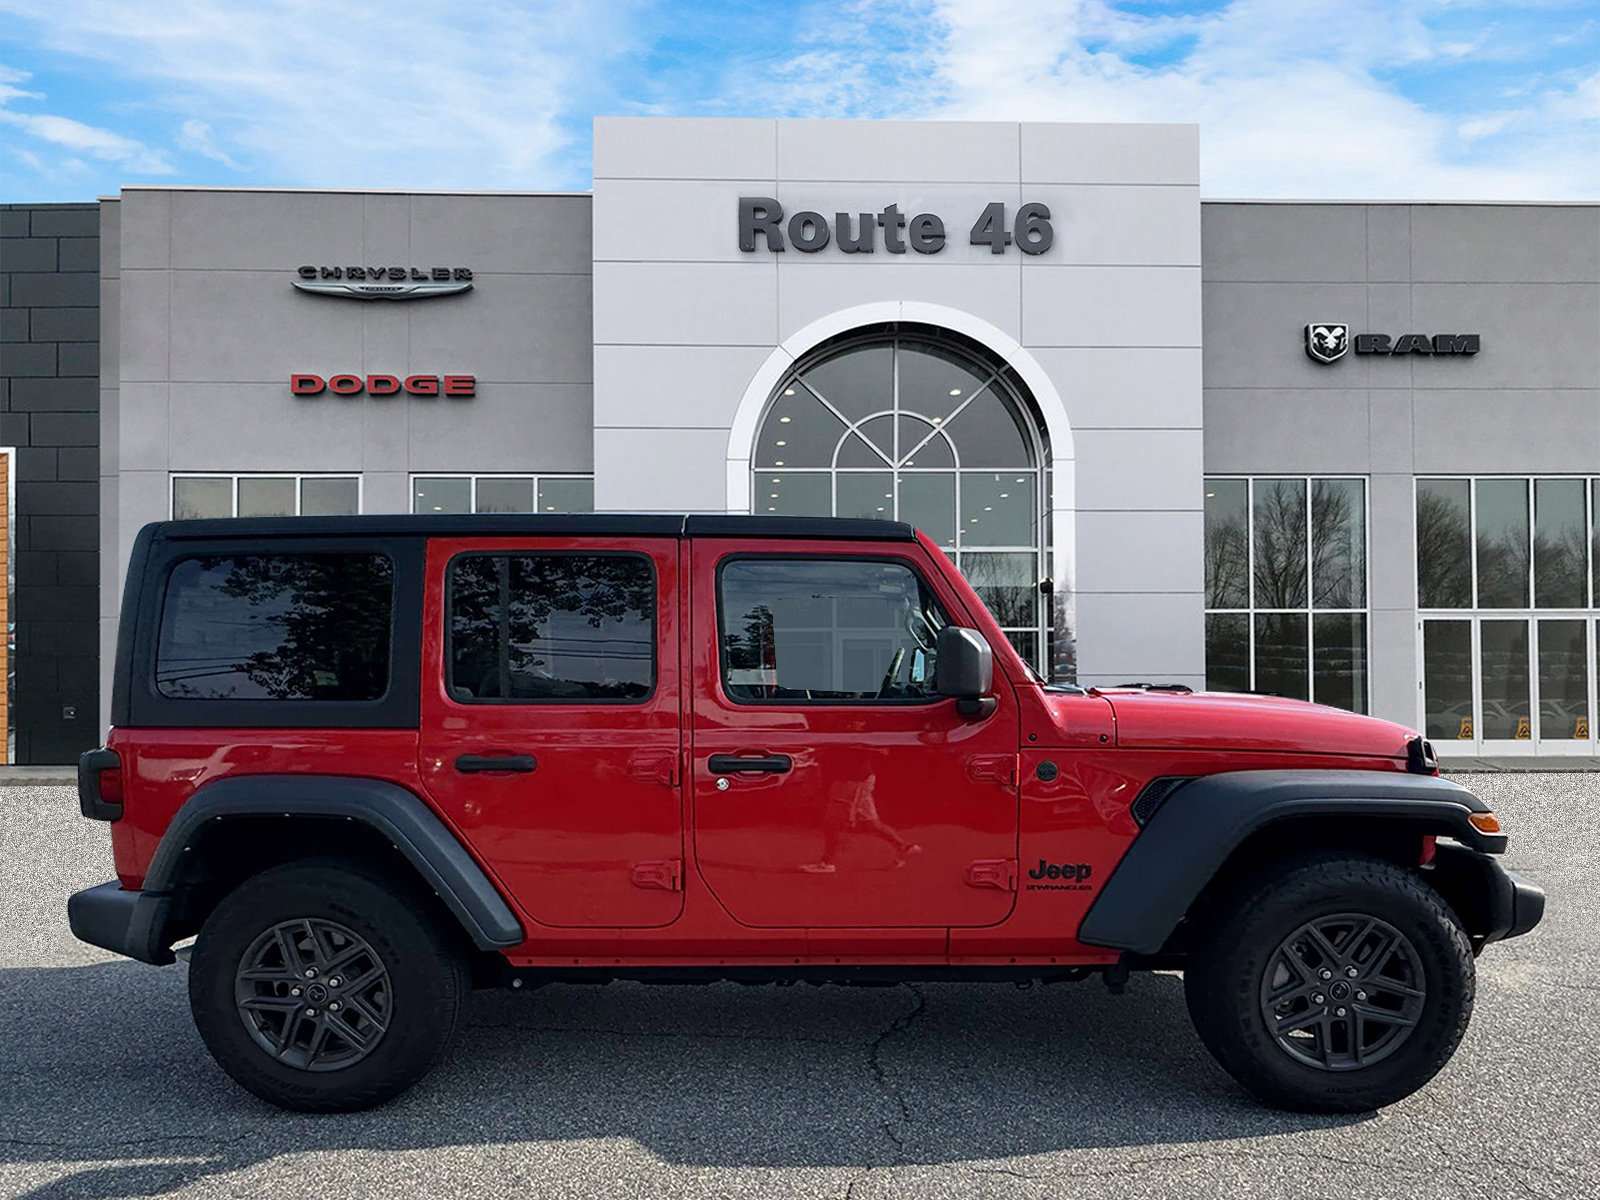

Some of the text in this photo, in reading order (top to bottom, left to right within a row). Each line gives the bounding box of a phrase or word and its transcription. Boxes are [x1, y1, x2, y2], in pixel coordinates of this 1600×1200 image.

[738, 196, 1054, 255] Route 46
[298, 265, 474, 280] CHRYSLER
[1354, 333, 1481, 356] RAM
[290, 373, 476, 397] DODGE
[1029, 859, 1092, 883] Jeep
